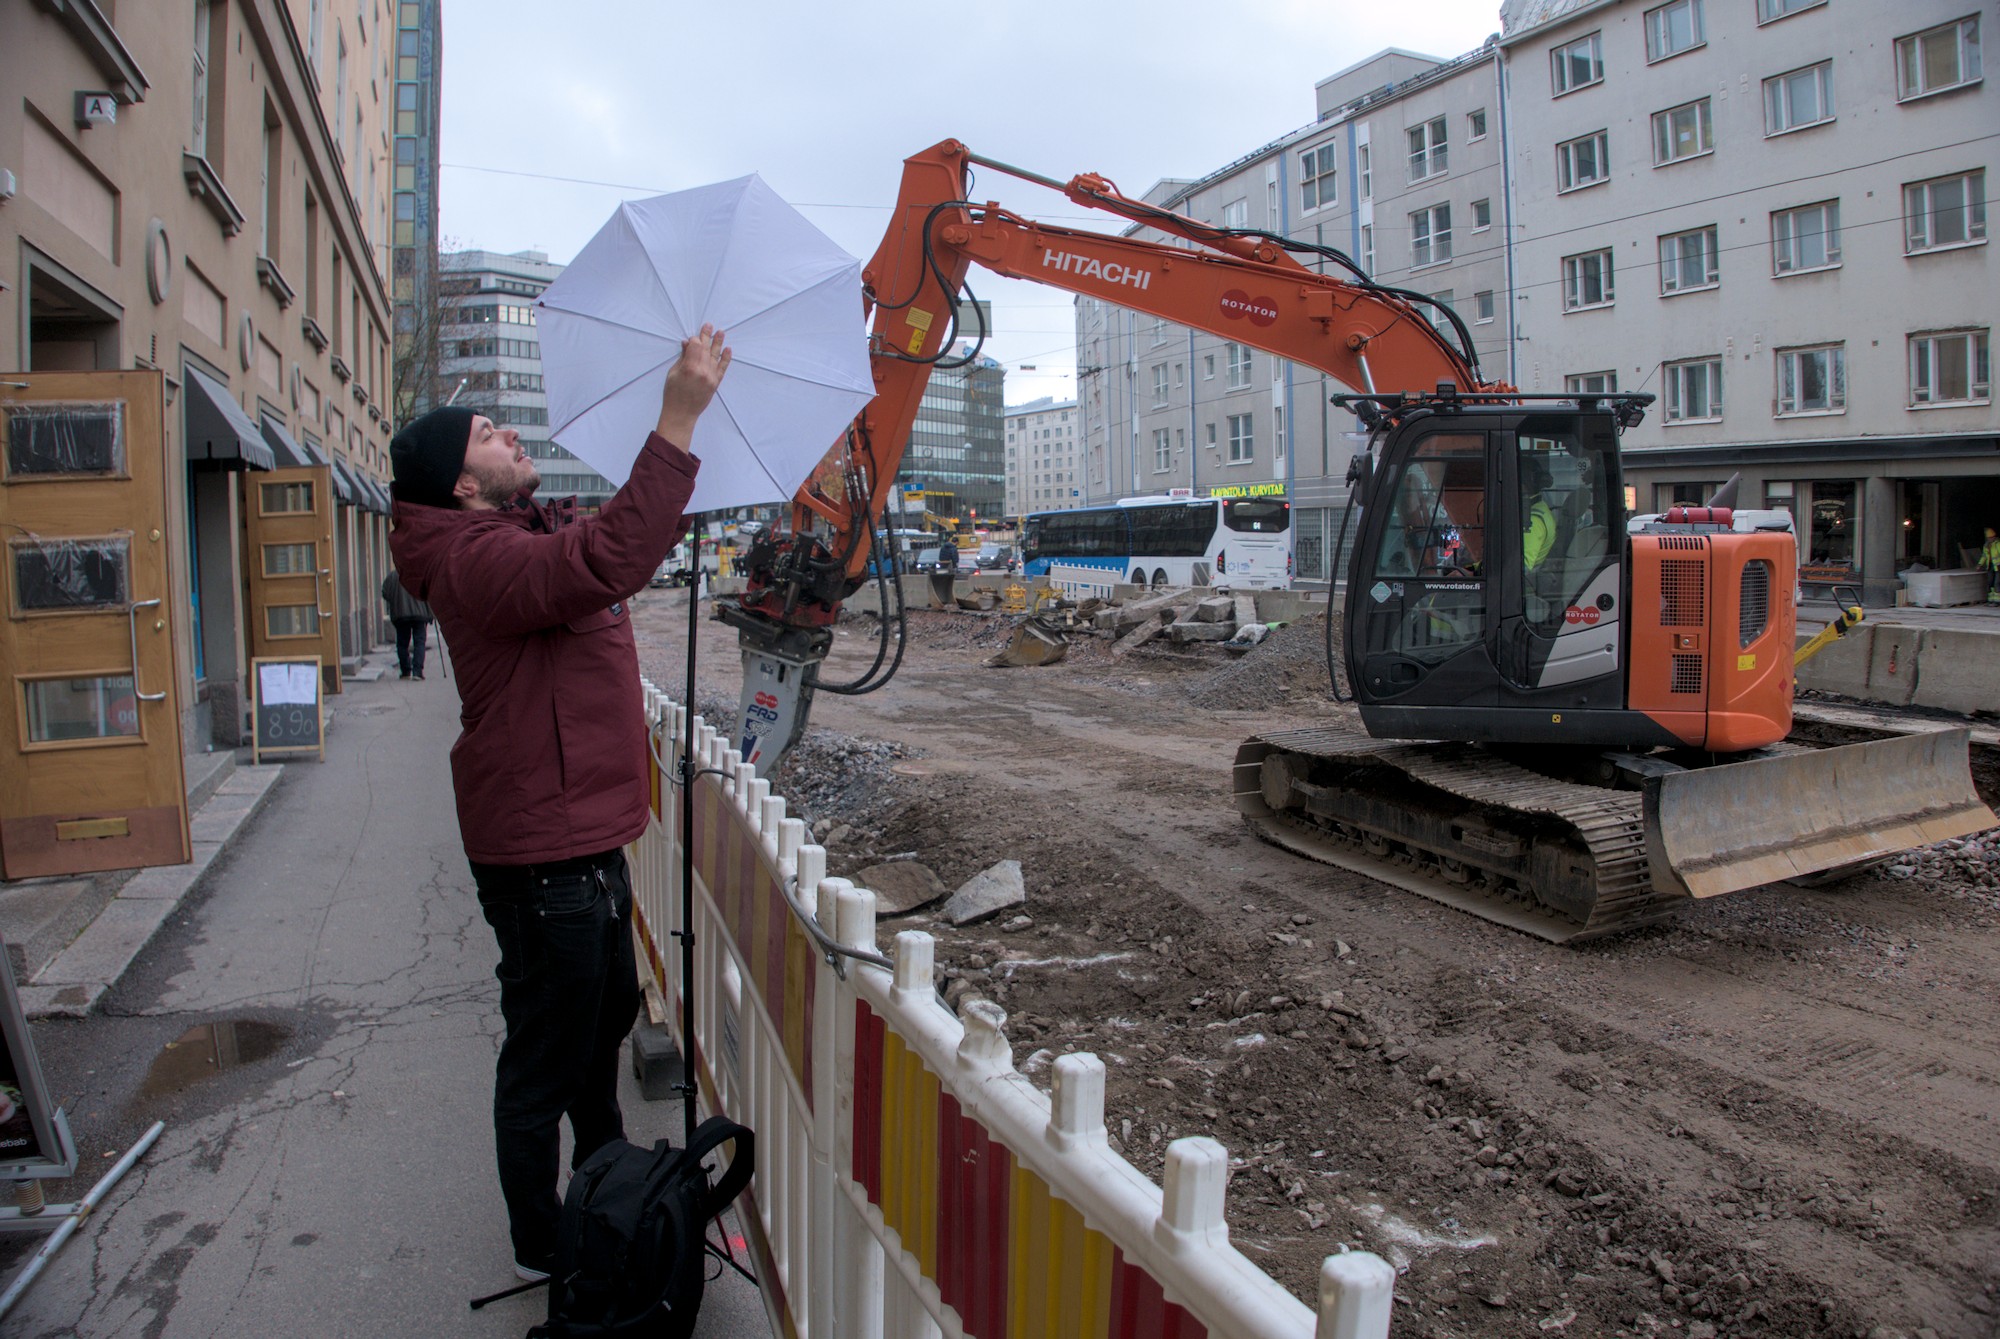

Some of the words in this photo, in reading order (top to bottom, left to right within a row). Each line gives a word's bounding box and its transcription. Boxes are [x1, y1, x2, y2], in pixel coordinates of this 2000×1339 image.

[90, 98, 103, 114] A
[1042, 249, 1151, 290] HITACHI
[1221, 298, 1277, 319] ROTATOR
[1250, 483, 1285, 497] KURVITAR
[747, 704, 778, 721] FRD
[0, 1138, 28, 1148] ebab
